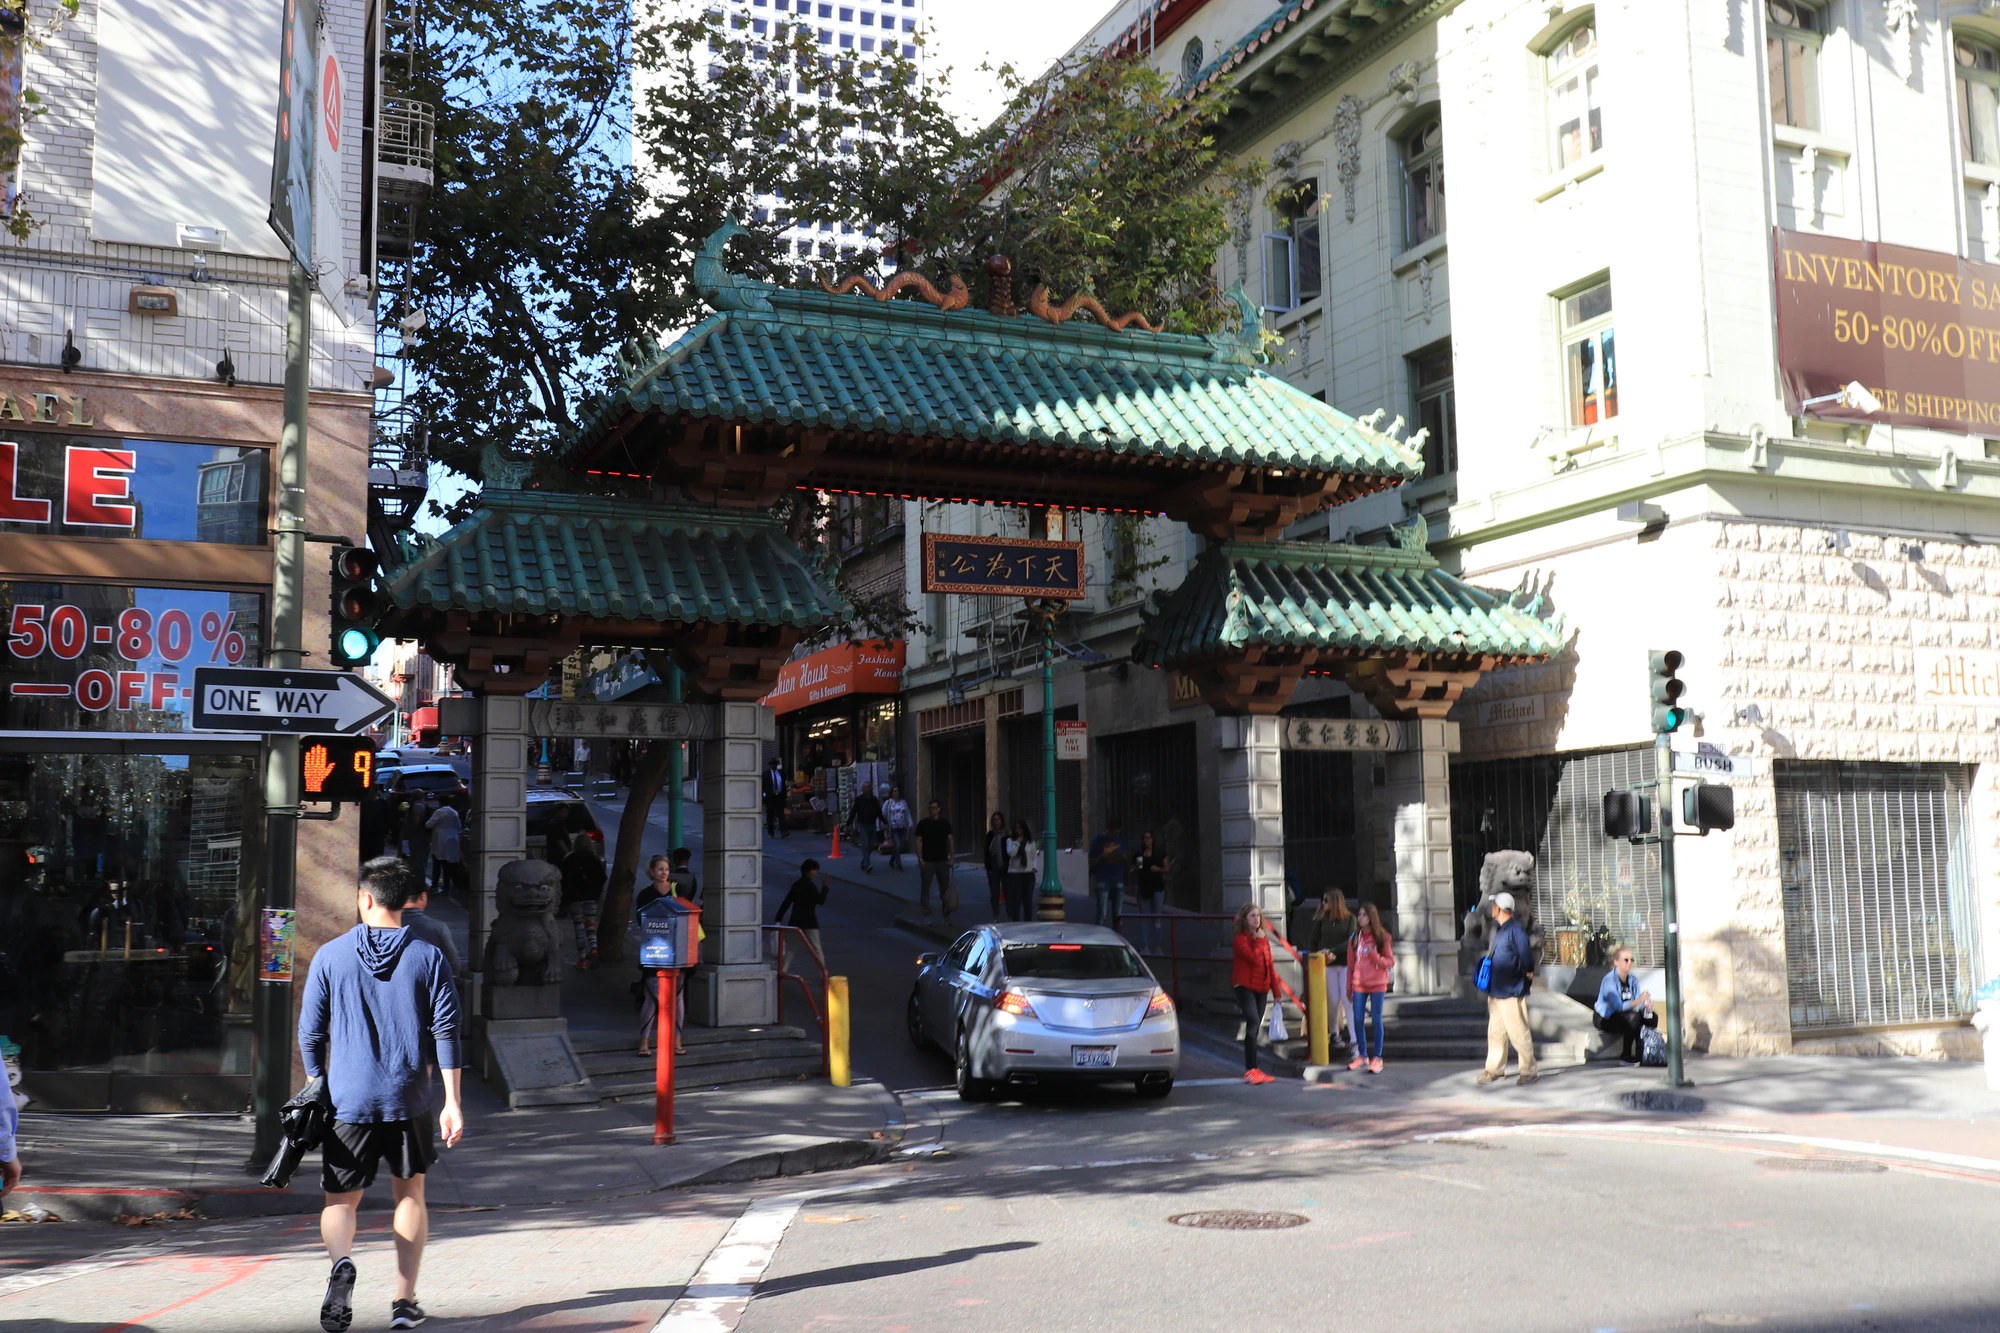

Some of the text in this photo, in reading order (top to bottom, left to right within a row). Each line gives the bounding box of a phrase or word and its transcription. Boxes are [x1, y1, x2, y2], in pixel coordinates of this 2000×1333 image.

[1782, 249, 1963, 305] INVENTORY
[0, 391, 94, 427] AEL
[1839, 384, 2000, 427] FEE SHIPPING
[0, 441, 136, 528] LE
[857, 653, 897, 665] Fashion
[800, 661, 829, 689] House
[210, 688, 329, 714] ONE WAY
[809, 690, 820, 702] Gifts
[824, 681, 847, 697] Souvenirs
[1487, 698, 1535, 724] Michael
[1056, 728, 1066, 736] NO
[353, 750, 371, 788] 9
[1694, 756, 1732, 773] BUSH
